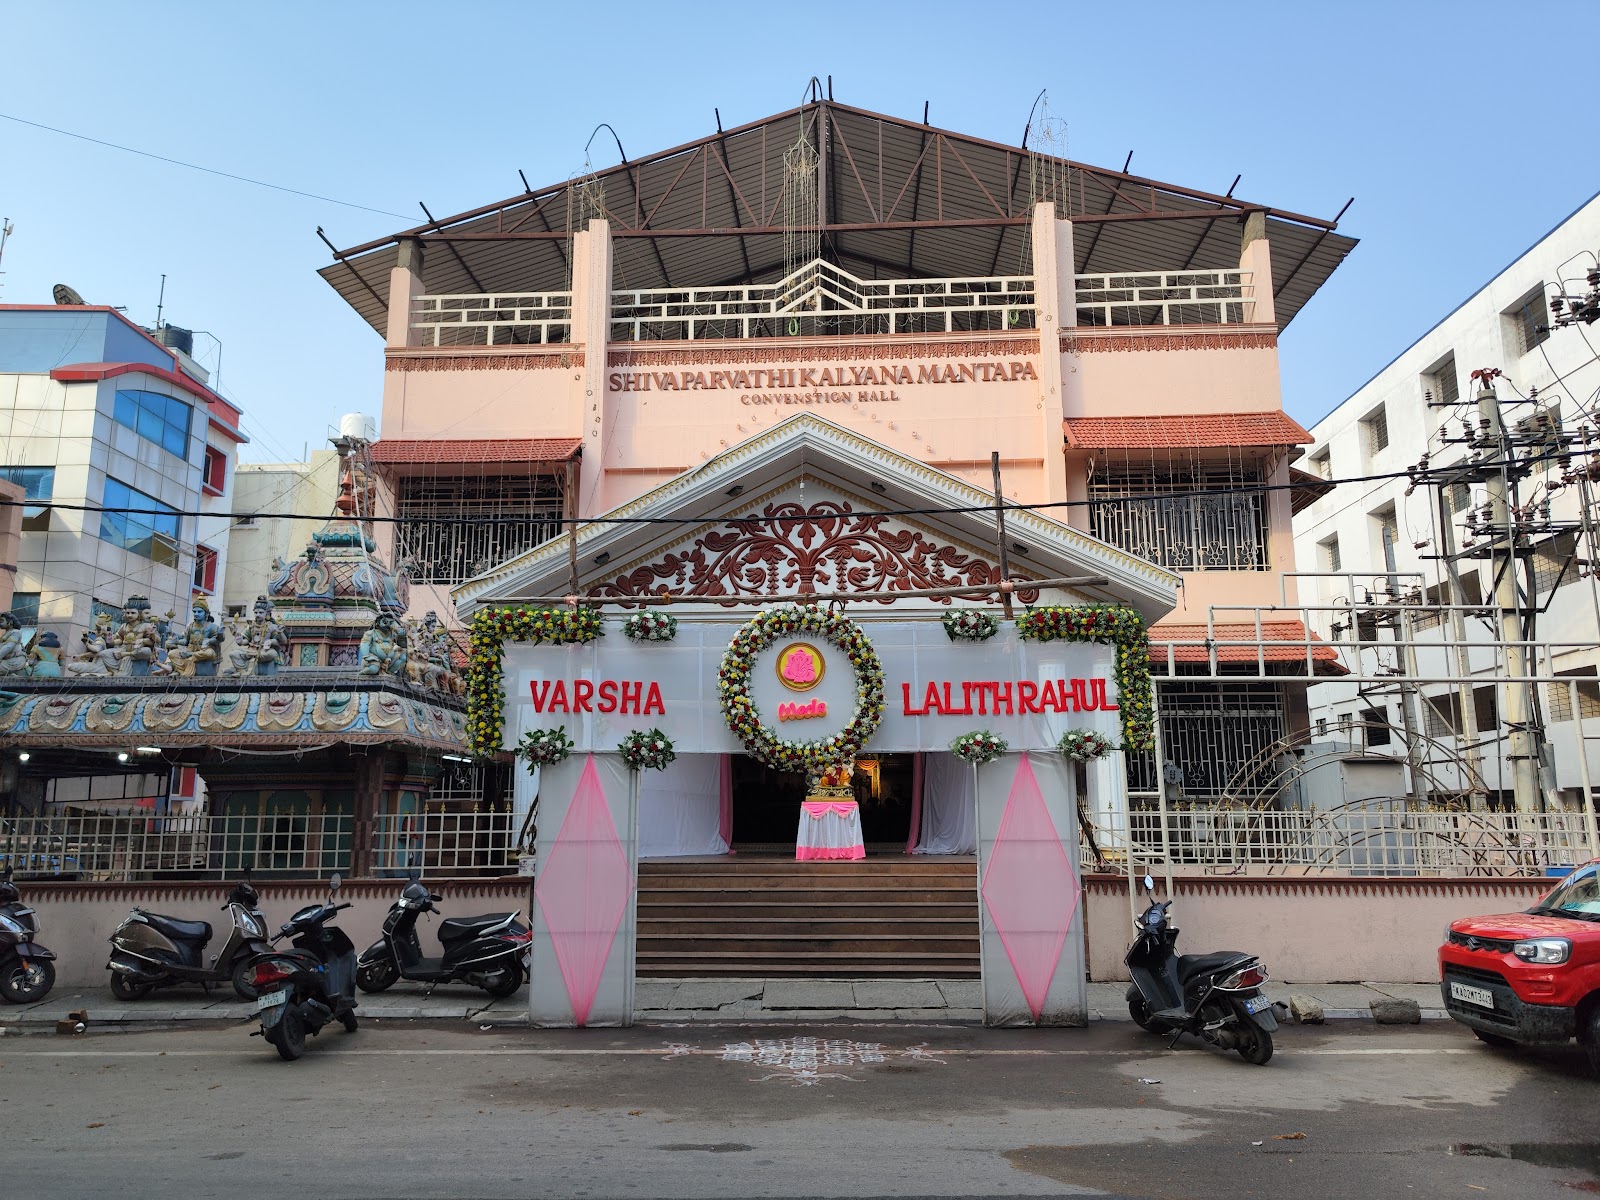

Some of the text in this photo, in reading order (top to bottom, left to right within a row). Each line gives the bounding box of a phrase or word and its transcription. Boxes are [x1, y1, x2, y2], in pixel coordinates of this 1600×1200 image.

[917, 361, 1039, 384] MANTAPA
[740, 390, 900, 406] CONVENSTION HALL
[529, 679, 666, 715] VARSHA
